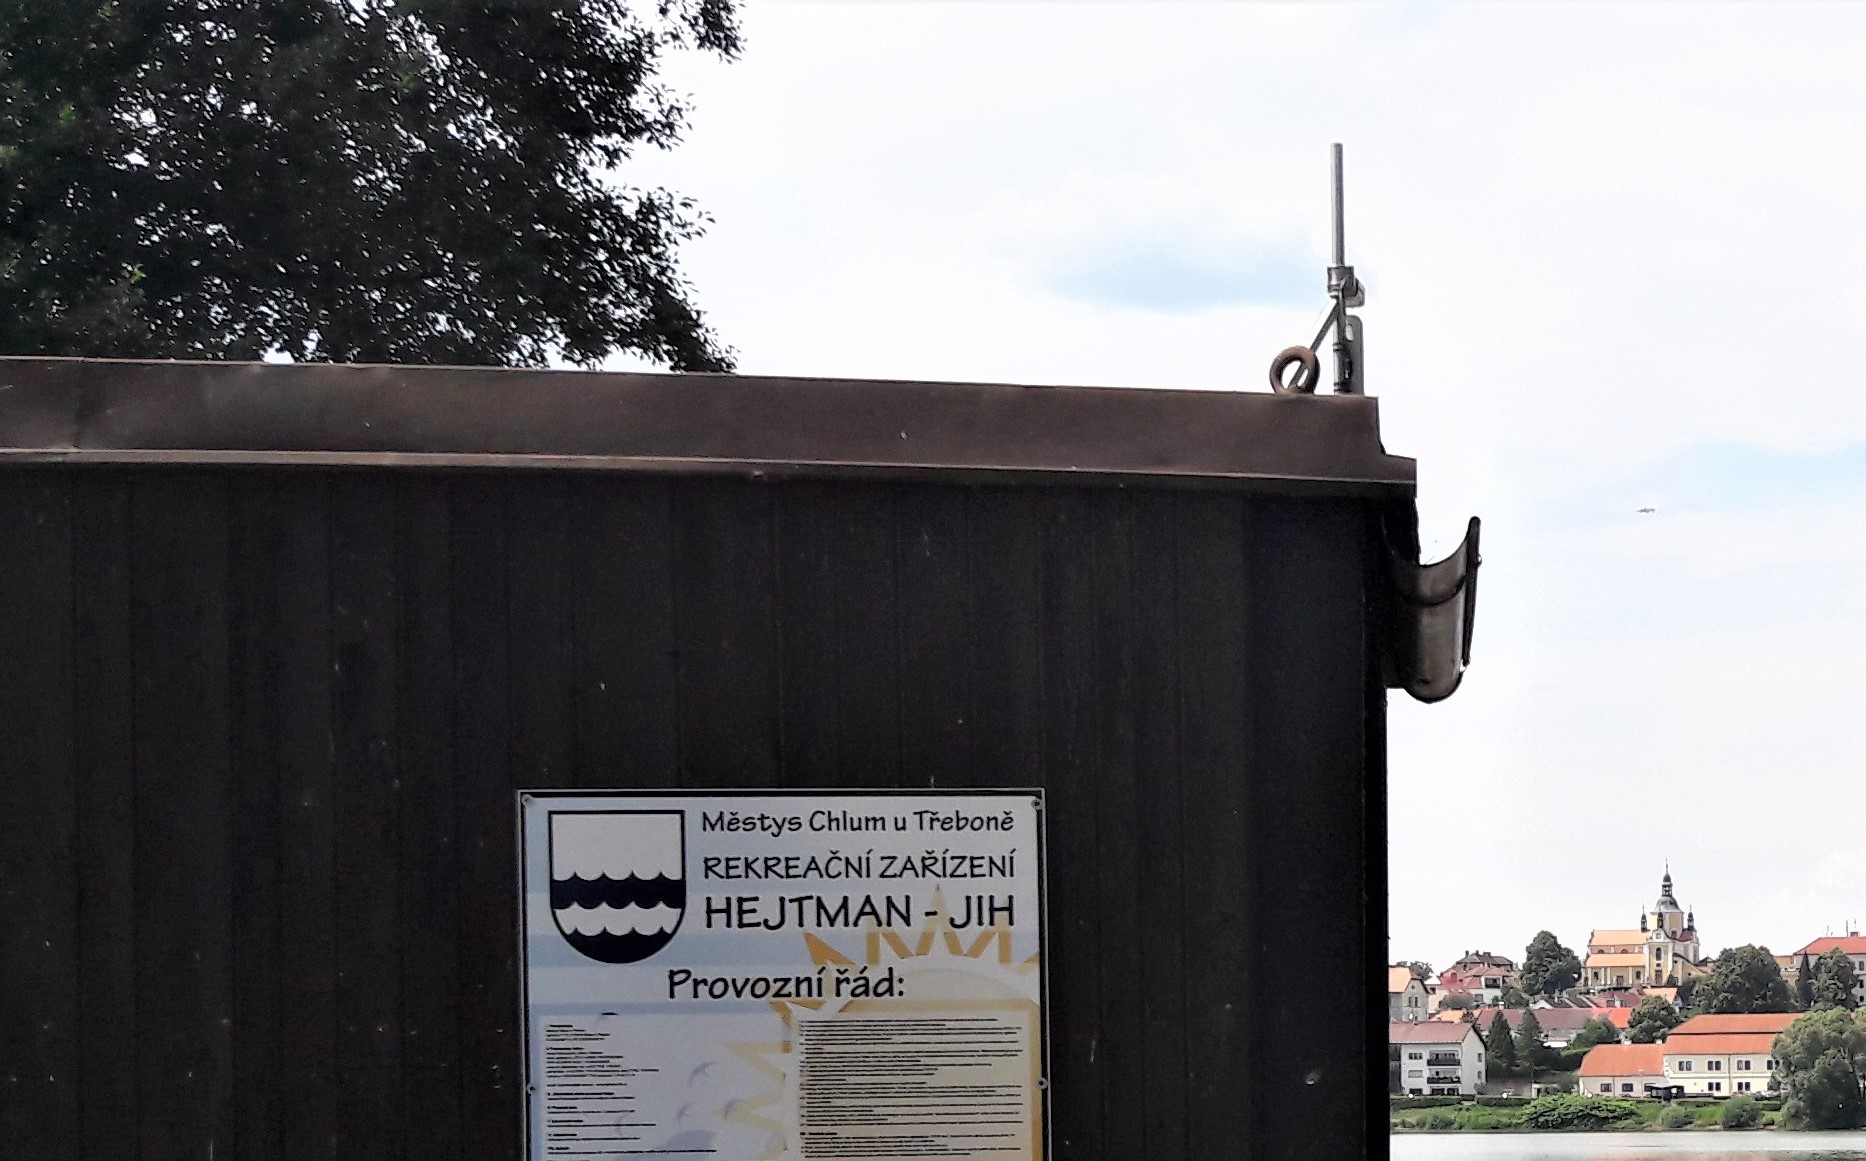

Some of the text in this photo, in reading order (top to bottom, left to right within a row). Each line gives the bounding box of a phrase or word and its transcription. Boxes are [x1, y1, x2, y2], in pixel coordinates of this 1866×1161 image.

[702, 810, 1014, 837] Městys Chlum u Třeboně
[703, 848, 1017, 880] REKREAČNÍ ZAŘÍZENÍ
[705, 895, 1015, 930] HEJTMAN - JIH
[668, 967, 904, 1000] Provozní řád:
